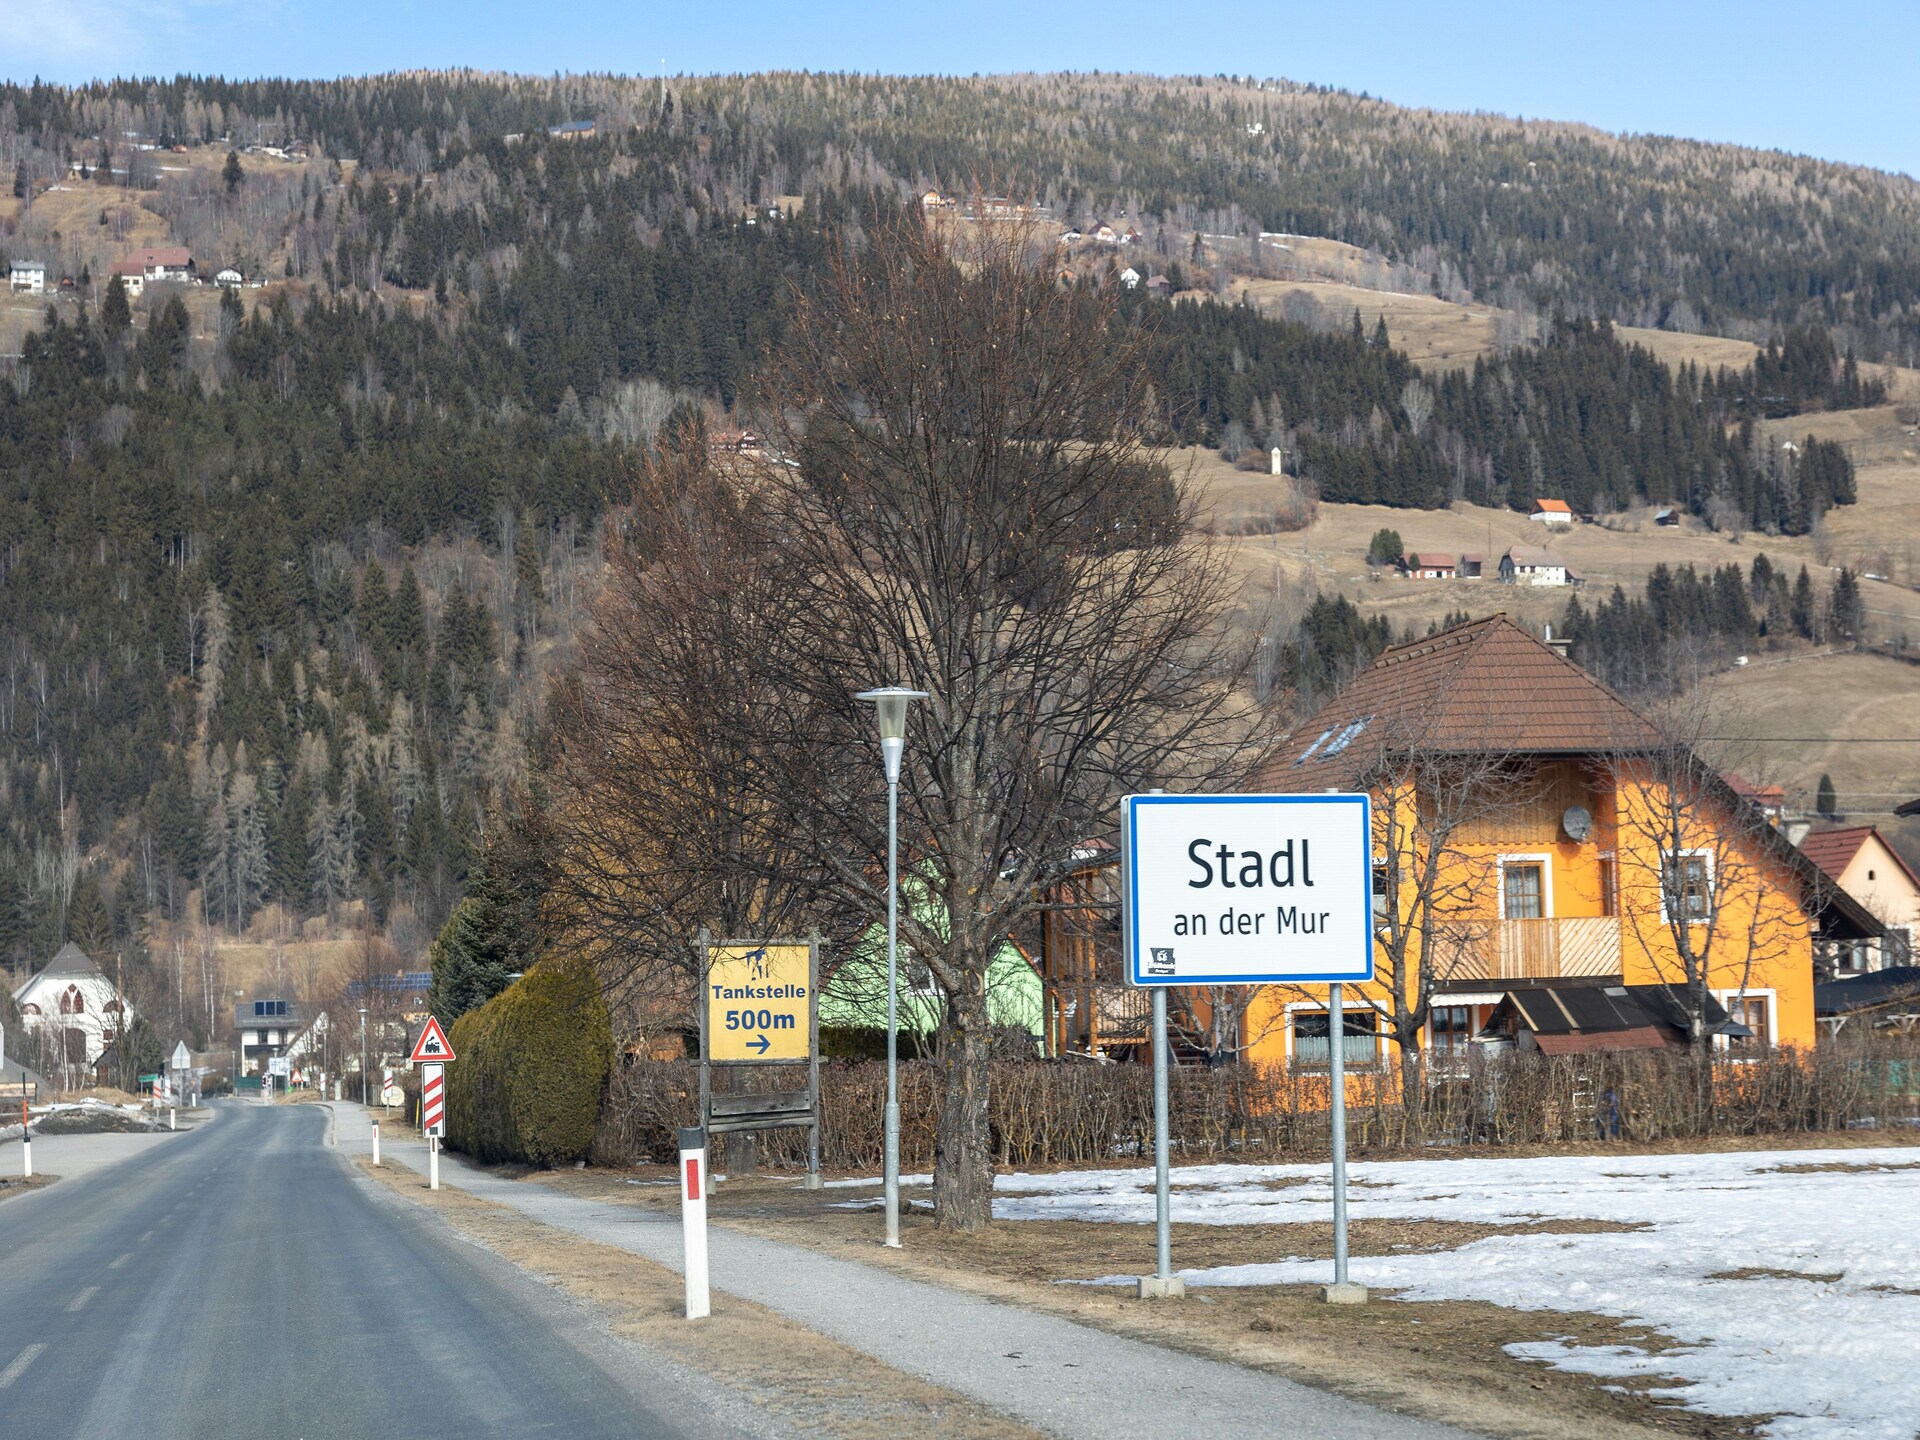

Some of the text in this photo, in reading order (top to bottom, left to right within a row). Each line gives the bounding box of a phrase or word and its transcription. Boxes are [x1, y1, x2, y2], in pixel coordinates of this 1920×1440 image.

[1188, 838, 1314, 889] Stadl
[1173, 906, 1330, 936] an der Mur
[711, 984, 806, 1000] Tankstelle
[725, 1009, 795, 1031] 500m
